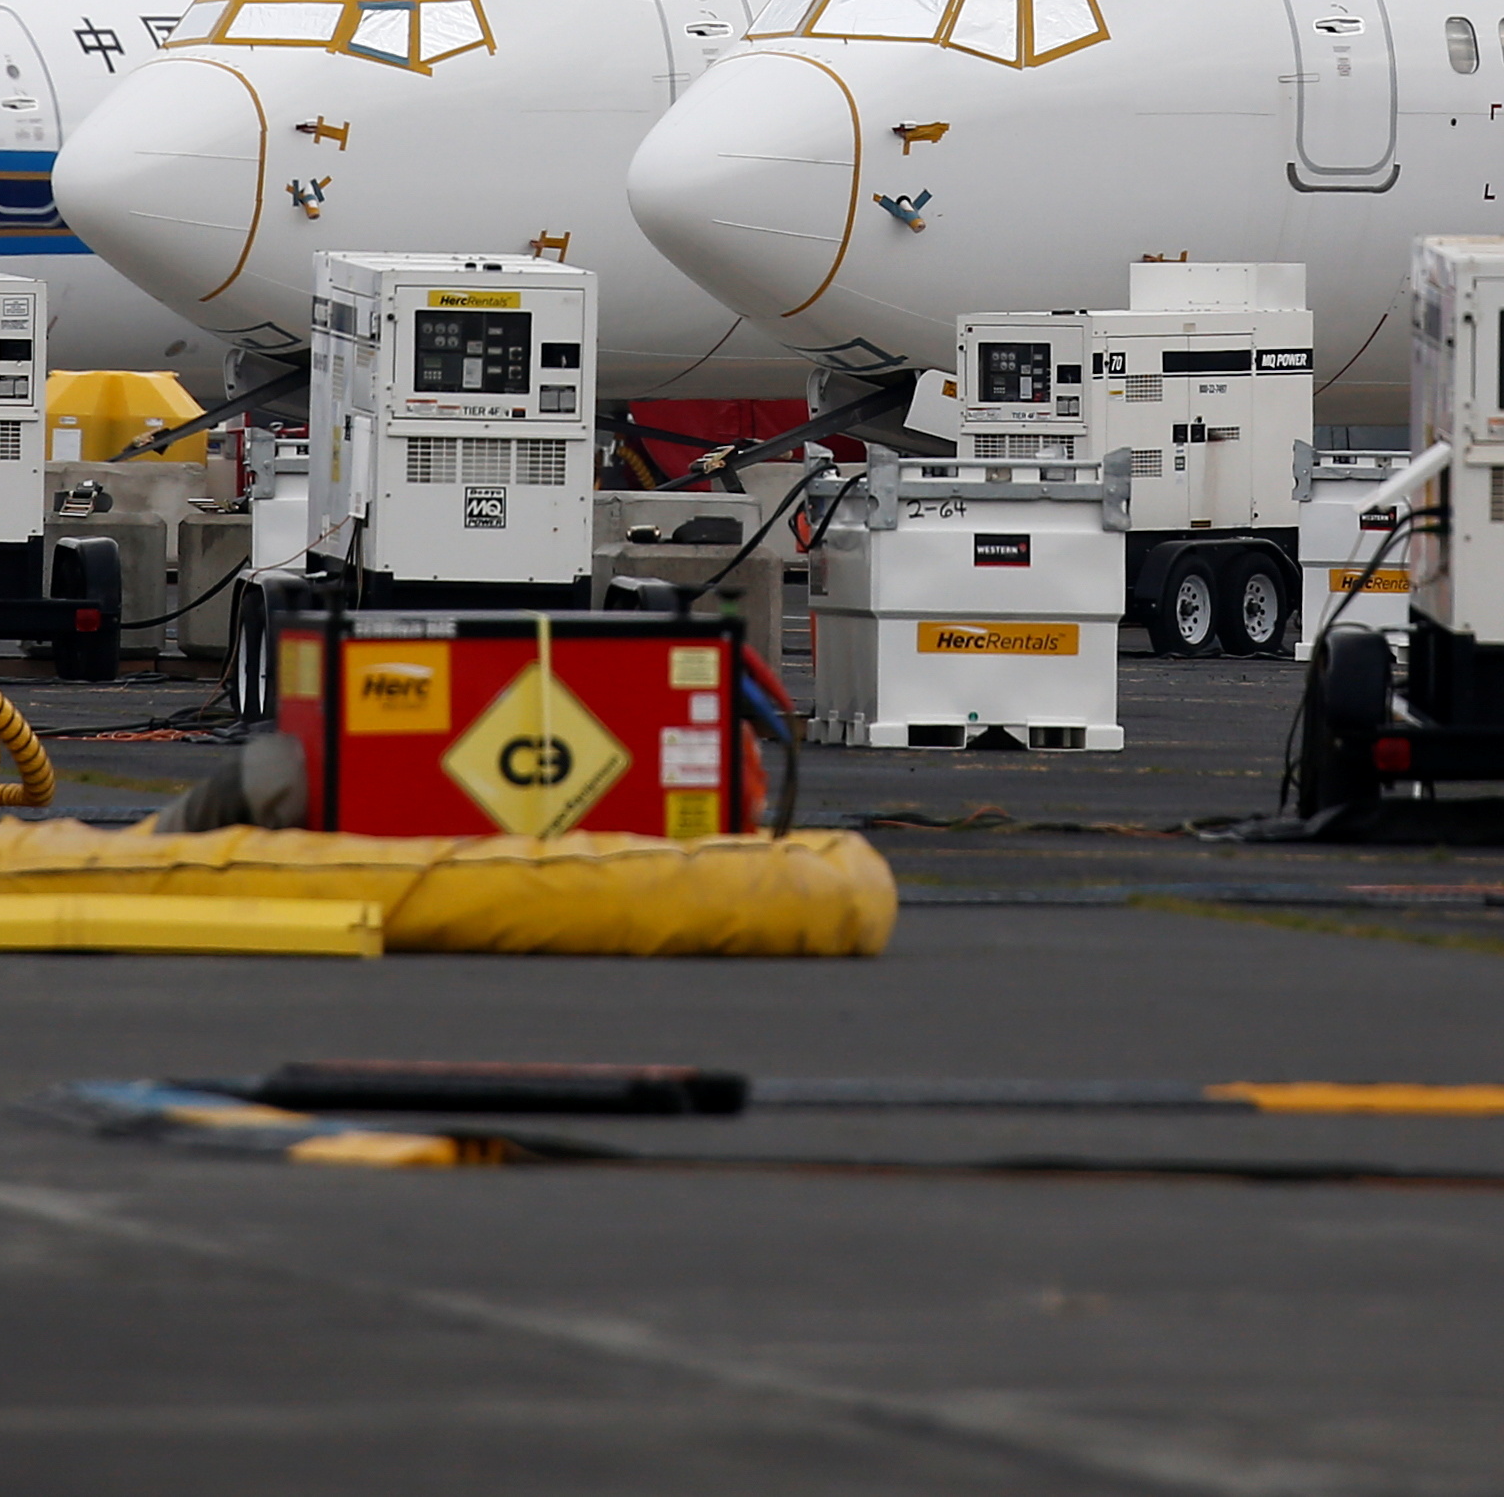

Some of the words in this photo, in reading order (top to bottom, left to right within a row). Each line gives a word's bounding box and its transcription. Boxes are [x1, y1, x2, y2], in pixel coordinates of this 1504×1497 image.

[1111, 356, 1123, 371] 70
[1261, 354, 1275, 368] MQ
[1276, 354, 1307, 367] POWER
[463, 406, 486, 416] TIER
[467, 499, 503, 516] MQ
[907, 500, 967, 519] 2-64
[977, 545, 1018, 553] WESTERN
